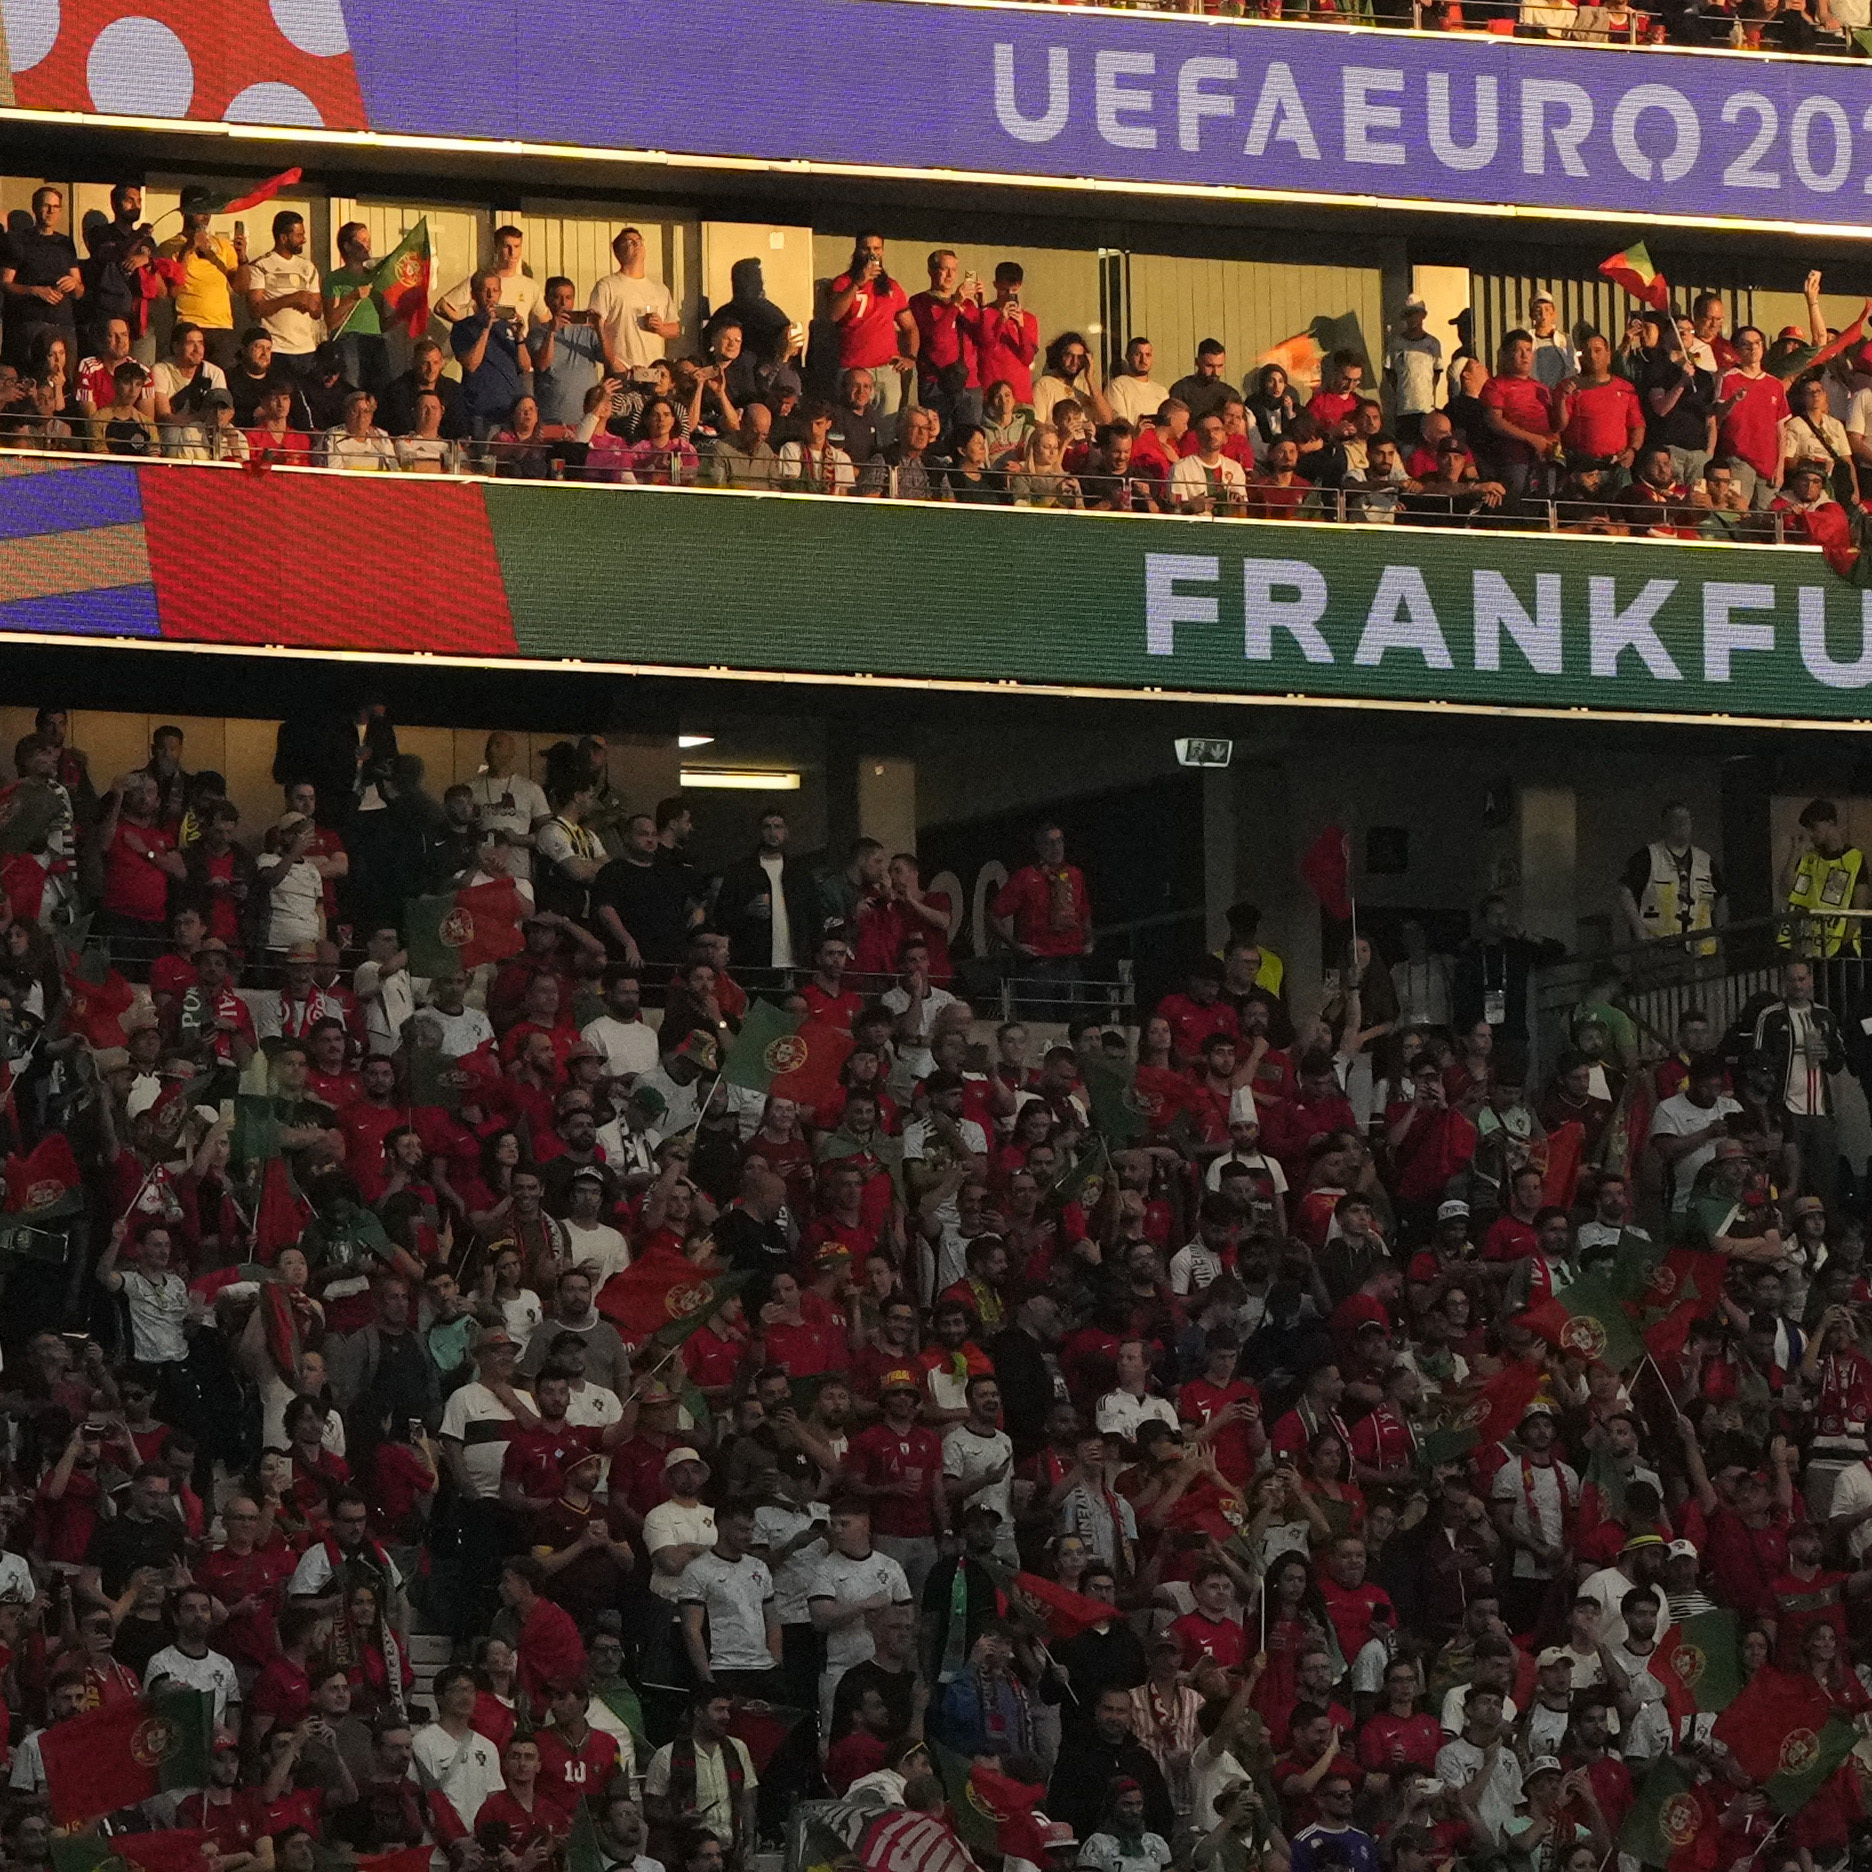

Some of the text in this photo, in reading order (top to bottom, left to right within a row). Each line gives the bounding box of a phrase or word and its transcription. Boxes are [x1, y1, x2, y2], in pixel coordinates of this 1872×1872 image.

[992, 42, 1322, 161] UEFA
[855, 293, 869, 319] 7
[1201, 1409, 1211, 1424] 7
[537, 1453, 547, 1471] 7
[1546, 1738, 1555, 1755] 7
[1660, 1736, 1670, 1750] 7
[564, 1760, 587, 1783] 10
[1113, 1861, 1123, 1872] 7
